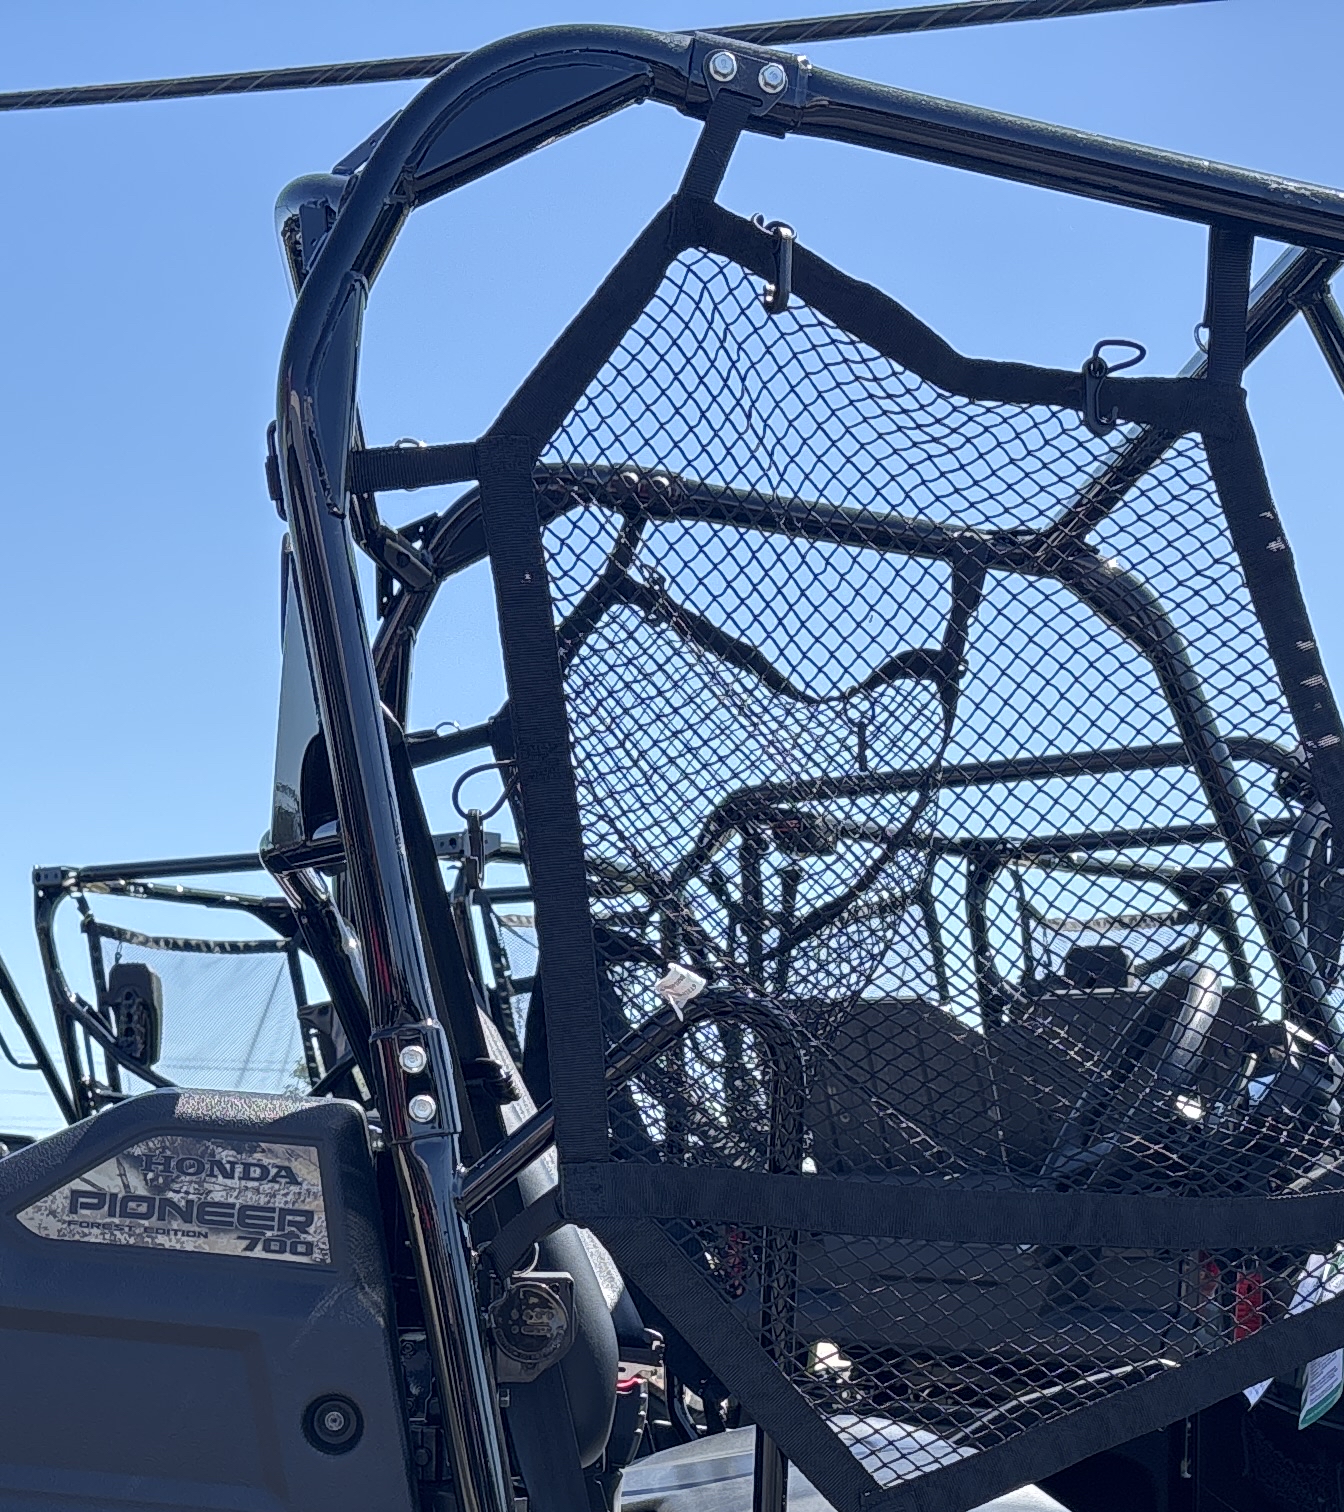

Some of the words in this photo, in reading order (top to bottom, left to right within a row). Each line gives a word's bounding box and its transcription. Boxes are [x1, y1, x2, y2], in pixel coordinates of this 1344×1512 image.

[142, 1153, 302, 1185] HONDA
[68, 1189, 315, 1235] PIONEER
[67, 1219, 136, 1233] FOREST
[143, 1226, 209, 1239] EDITION
[238, 1235, 314, 1256] 700
